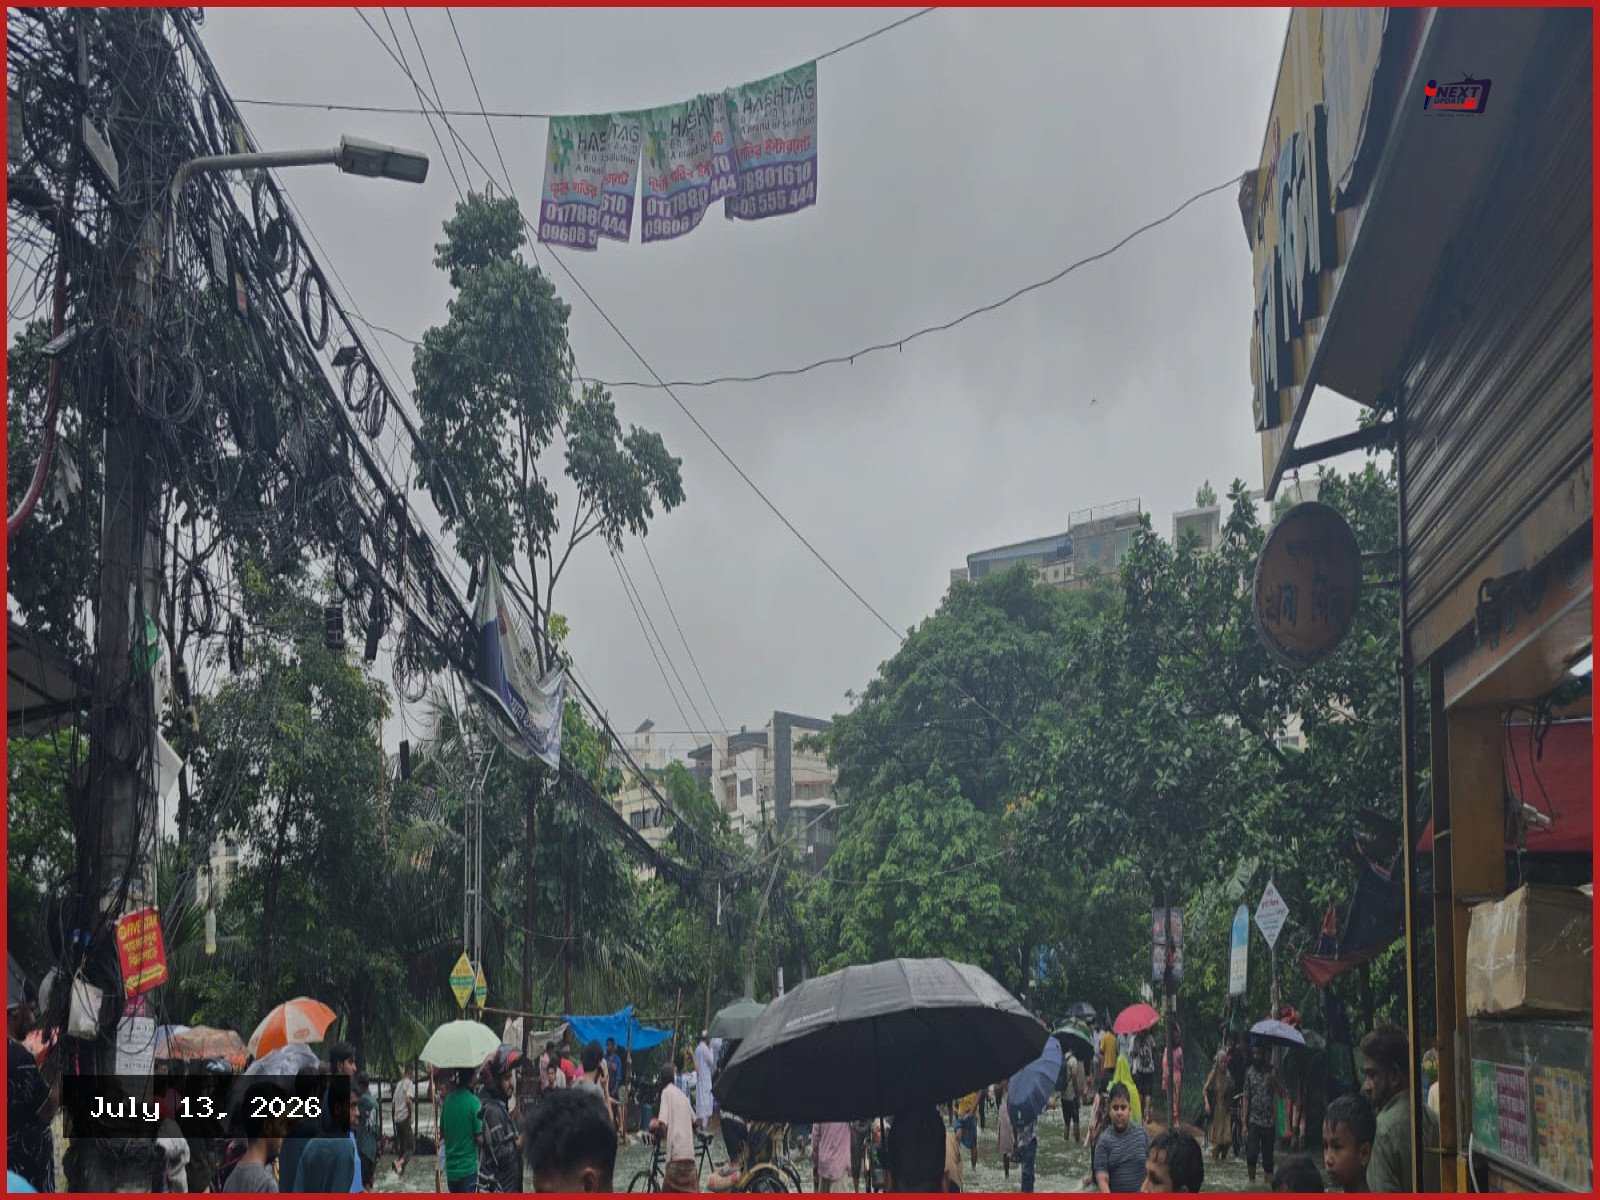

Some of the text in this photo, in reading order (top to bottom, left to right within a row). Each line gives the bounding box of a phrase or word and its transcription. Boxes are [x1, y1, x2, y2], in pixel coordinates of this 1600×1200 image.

[758, 189, 787, 213] 555
[789, 181, 814, 207] 444
[602, 213, 627, 235] 444
